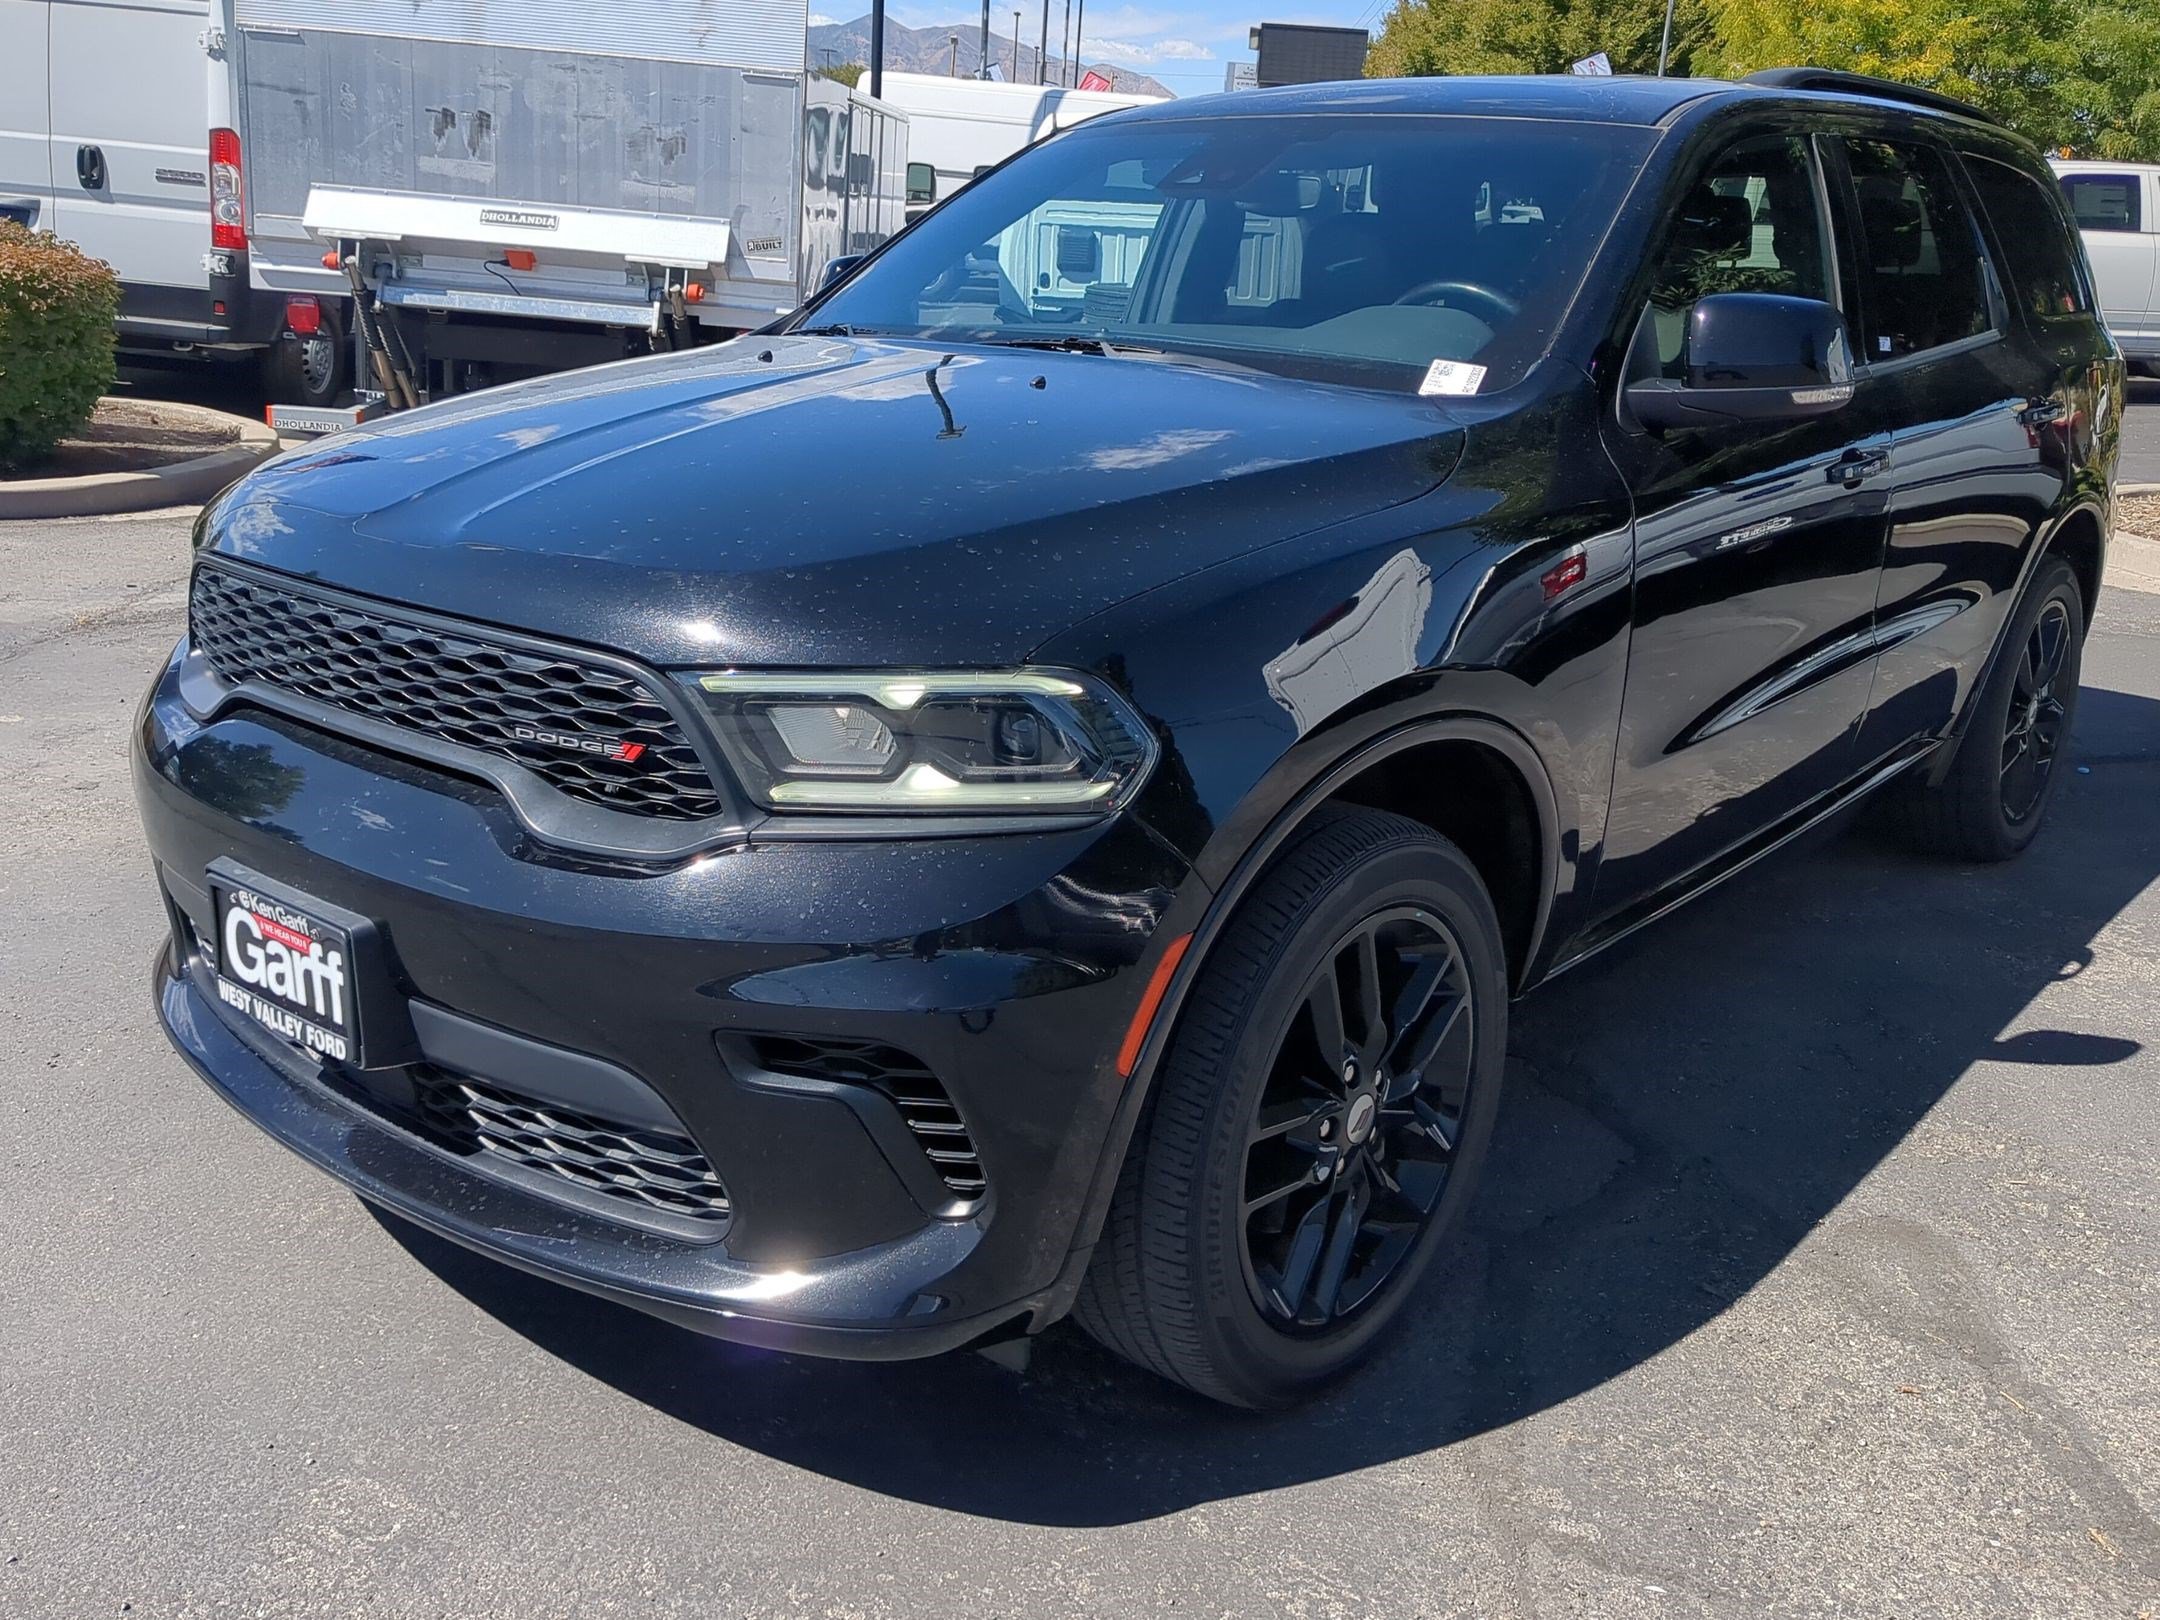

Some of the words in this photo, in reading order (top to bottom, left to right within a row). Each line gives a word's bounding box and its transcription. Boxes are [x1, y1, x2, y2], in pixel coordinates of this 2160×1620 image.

[482, 212, 556, 227] DHOLLANDIA
[755, 241, 783, 250] BUILT
[274, 420, 342, 432] DHOLLANDIA
[515, 727, 625, 756] DODGE
[225, 906, 344, 1026] Garff
[218, 979, 251, 1015] WEST
[253, 998, 303, 1040] VALLEY
[306, 1025, 346, 1060] FORD
